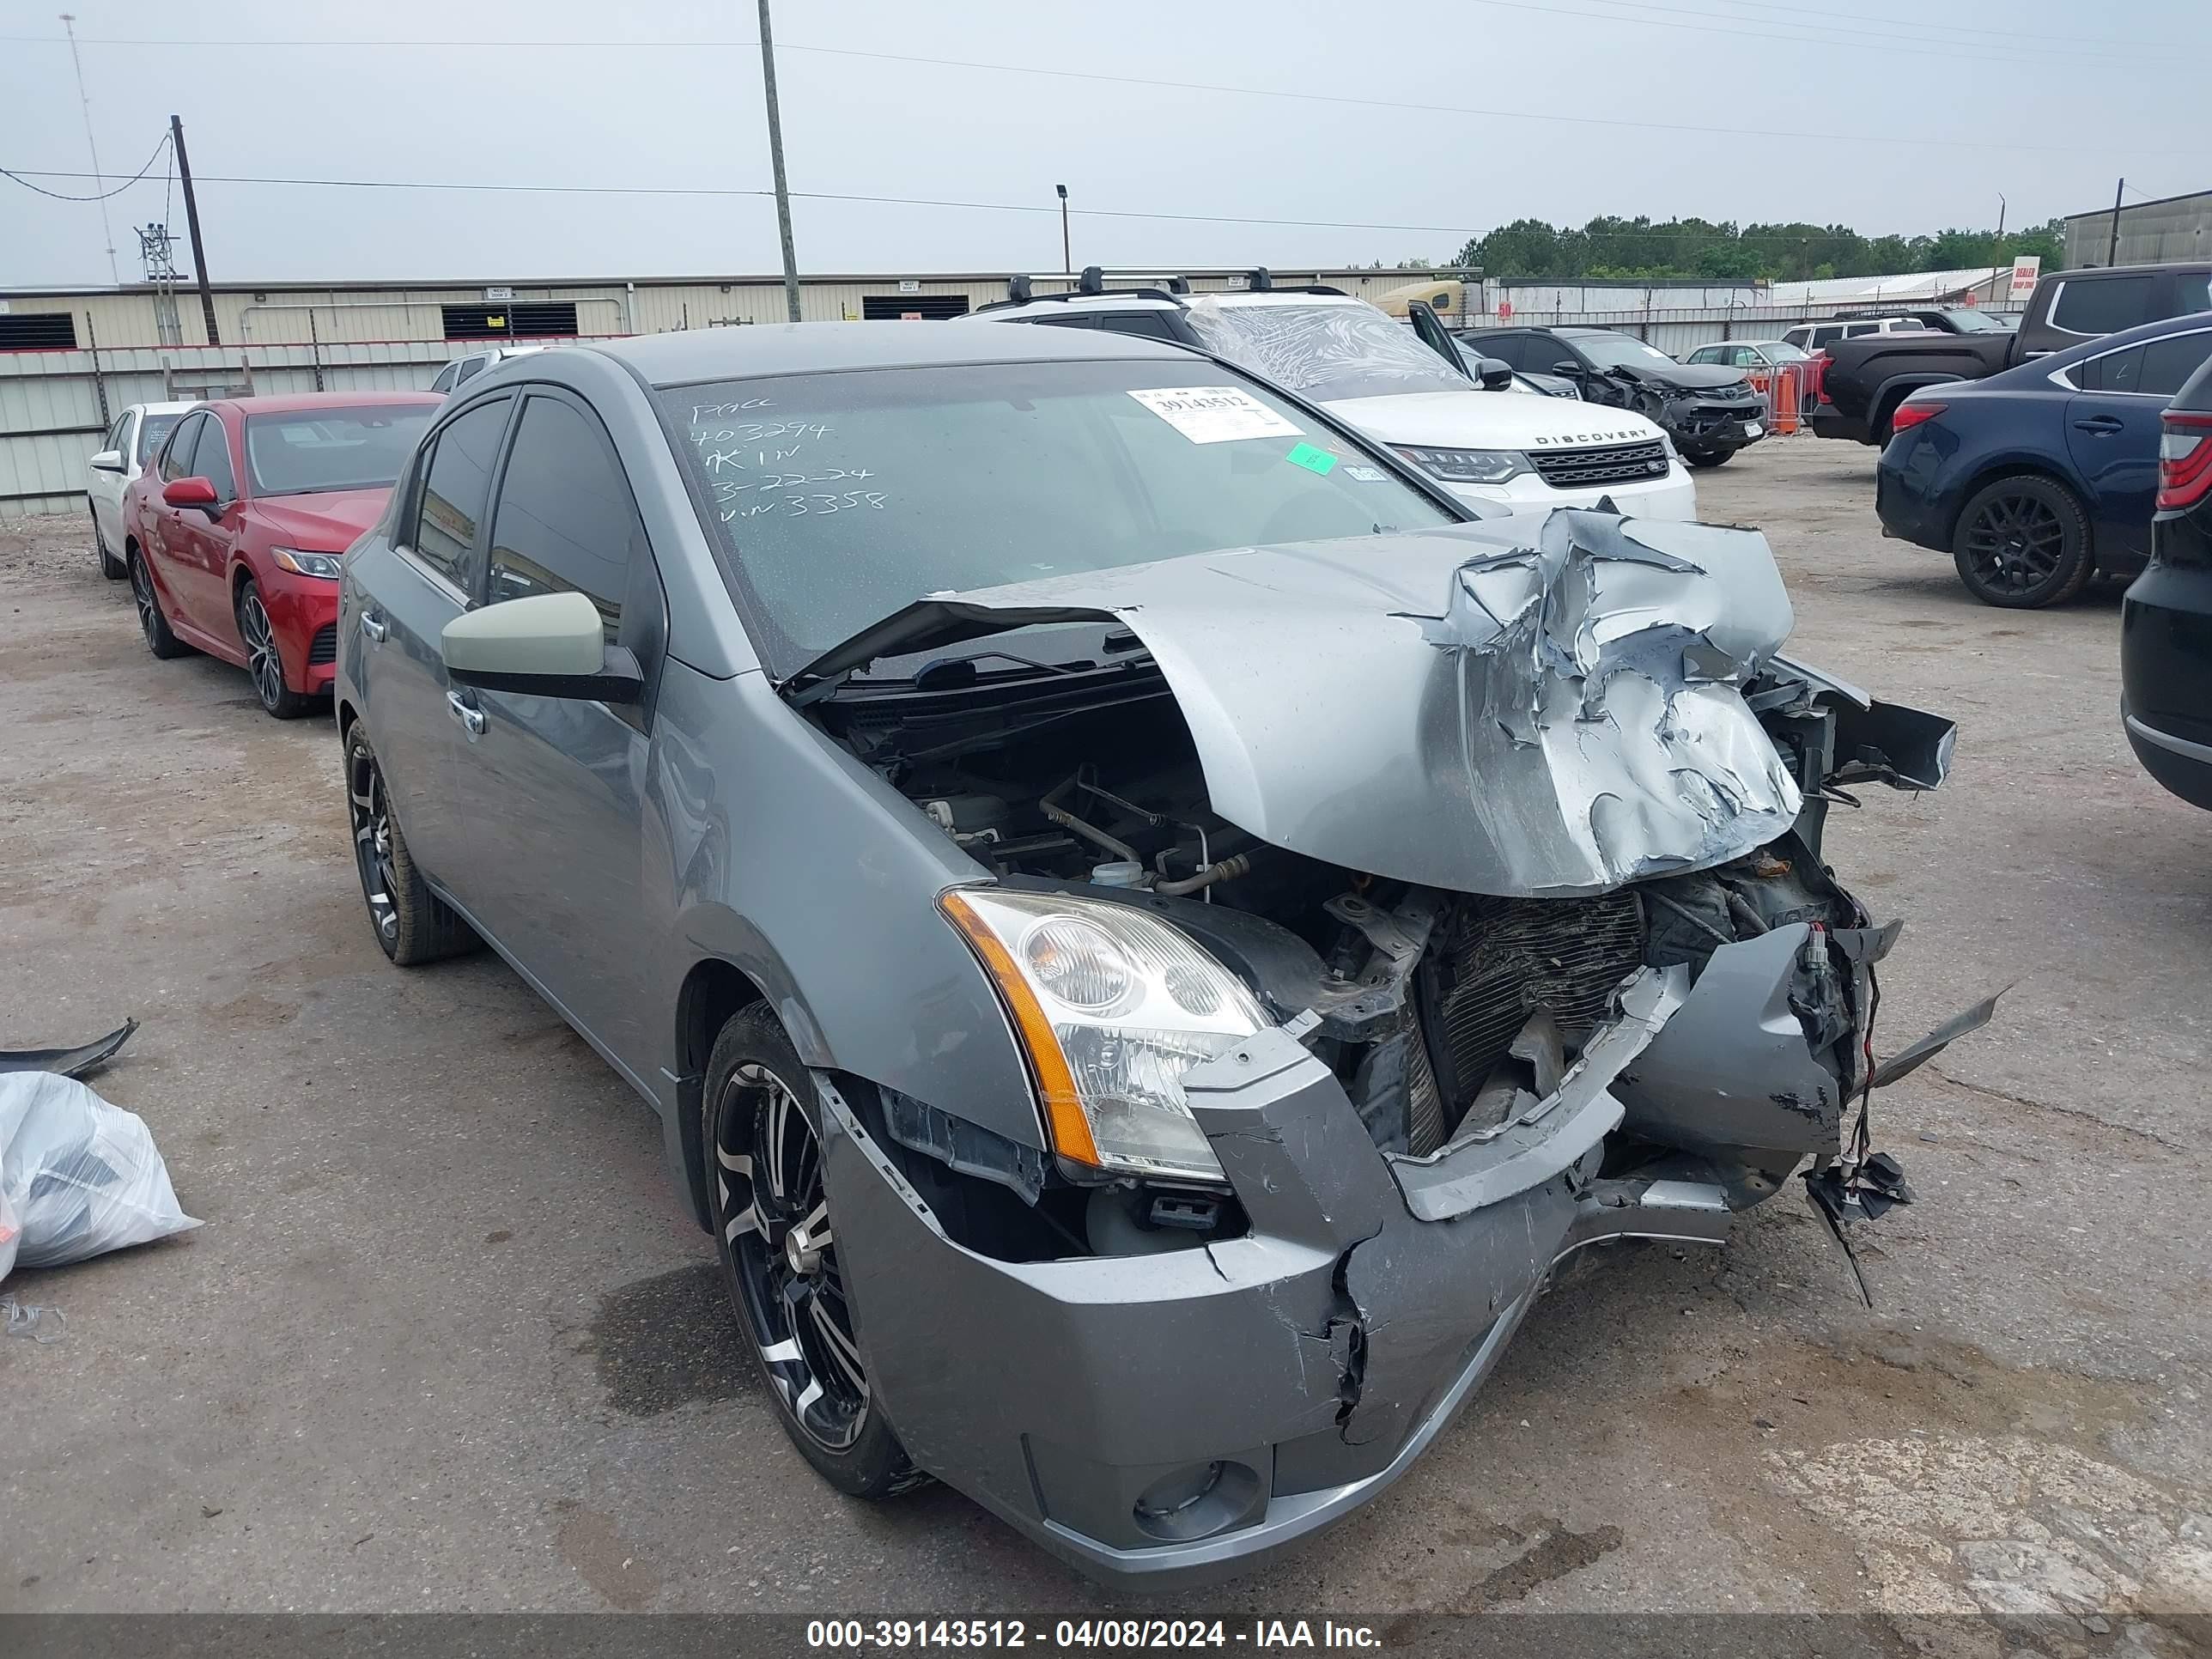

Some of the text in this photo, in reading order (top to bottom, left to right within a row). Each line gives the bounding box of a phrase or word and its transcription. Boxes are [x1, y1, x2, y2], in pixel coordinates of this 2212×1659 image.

[2015, 268, 2036, 277] DEALER
[1499, 304, 1511, 317] 50
[1157, 396, 1249, 411] 39143512
[690, 422, 836, 446] 403294
[1535, 429, 1648, 445] DISCOVERY
[711, 468, 875, 503] 3-22-24
[785, 490, 890, 516] 3358
